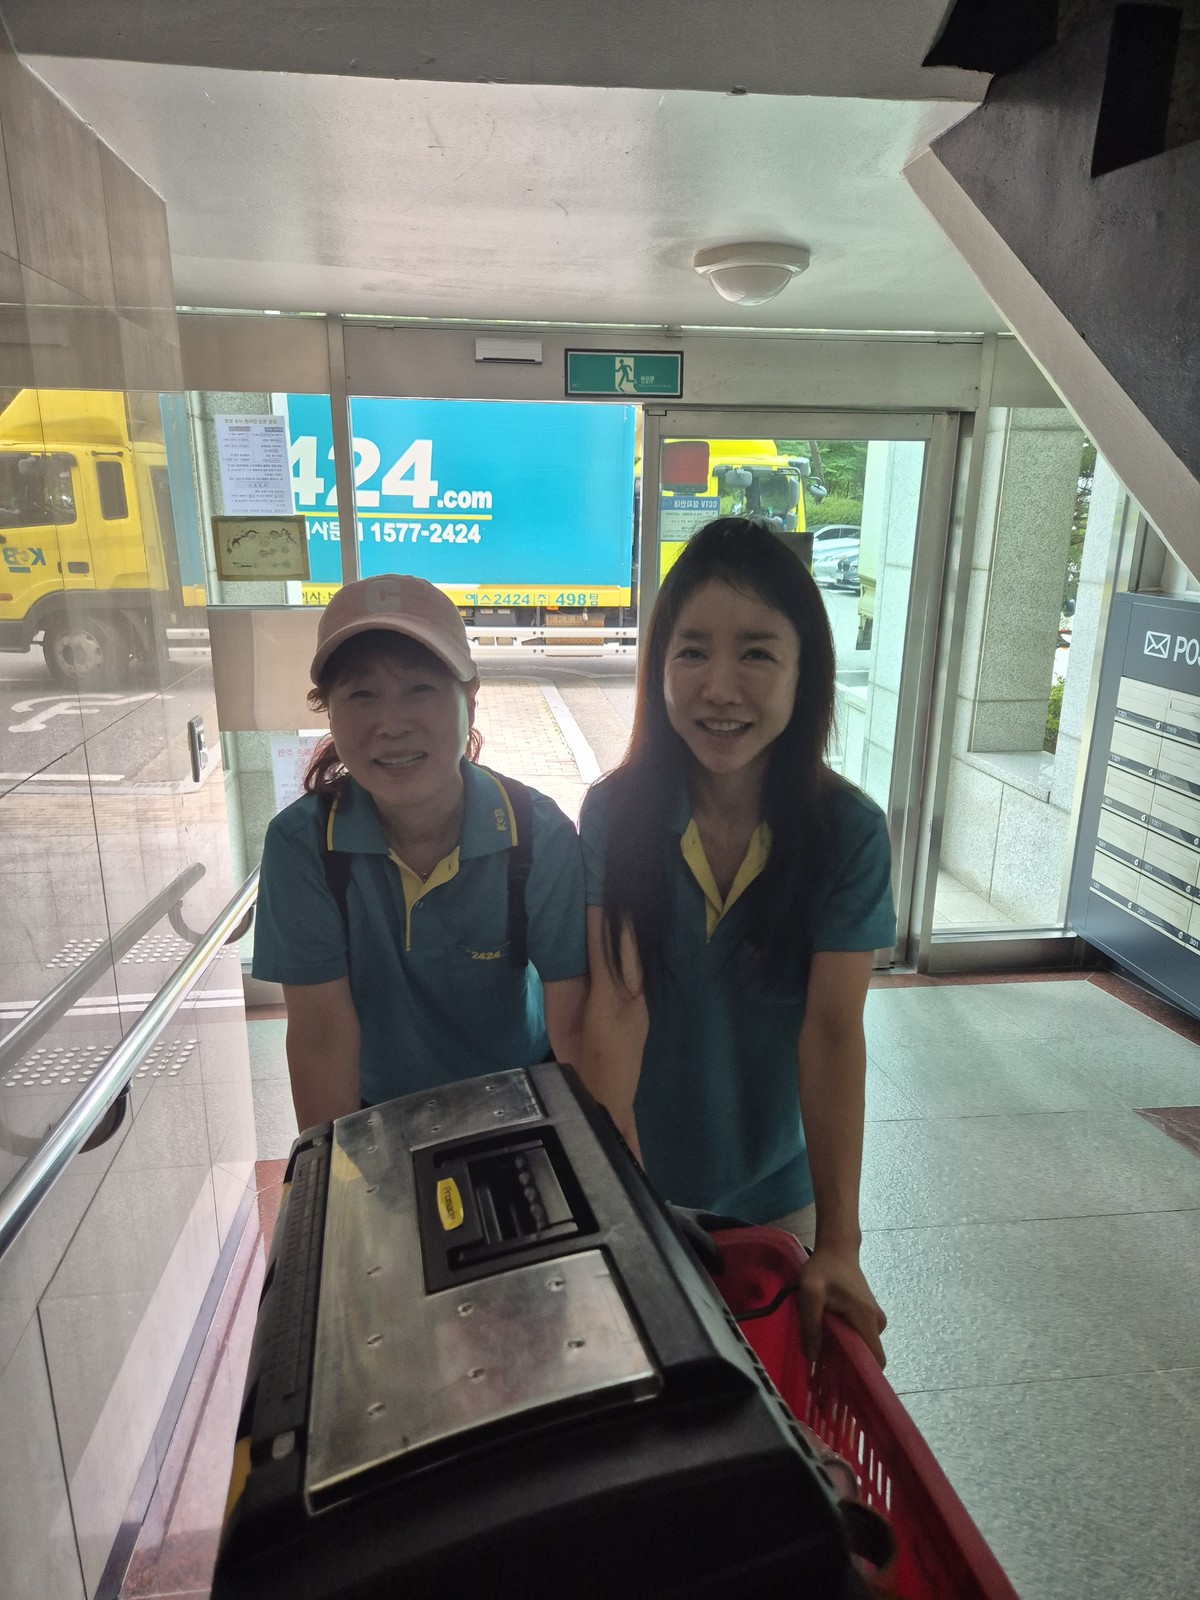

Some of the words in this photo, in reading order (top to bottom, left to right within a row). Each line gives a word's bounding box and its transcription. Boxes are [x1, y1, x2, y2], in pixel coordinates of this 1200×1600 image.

[370, 522, 481, 543] 1577-2424
[1173, 636, 1200, 667] PO
[1137, 907, 1146, 916] 201
[1189, 937, 1199, 947] 301
